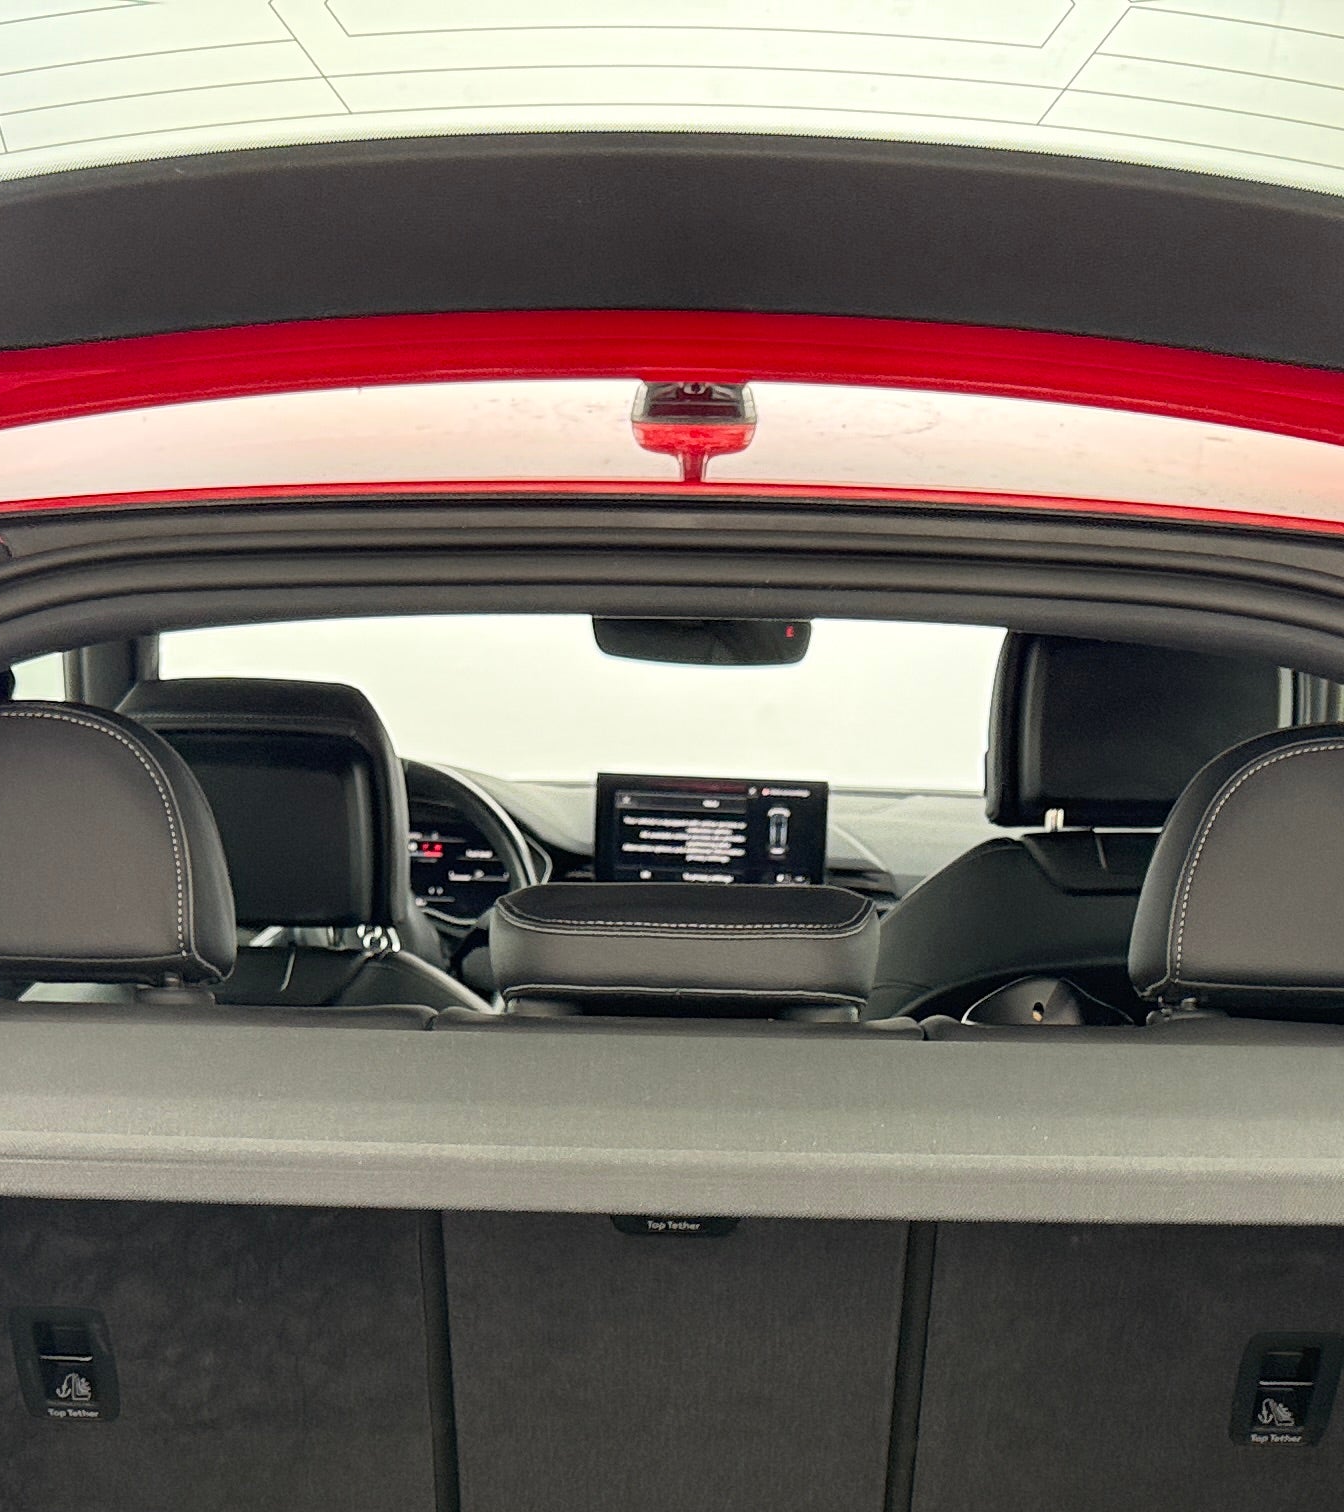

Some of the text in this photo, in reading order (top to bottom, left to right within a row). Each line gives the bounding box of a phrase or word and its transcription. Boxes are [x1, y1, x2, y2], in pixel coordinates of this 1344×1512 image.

[648, 1220, 700, 1231] Top Tether
[47, 1408, 99, 1418] Top Tether
[1251, 1434, 1302, 1443] Top Tether
